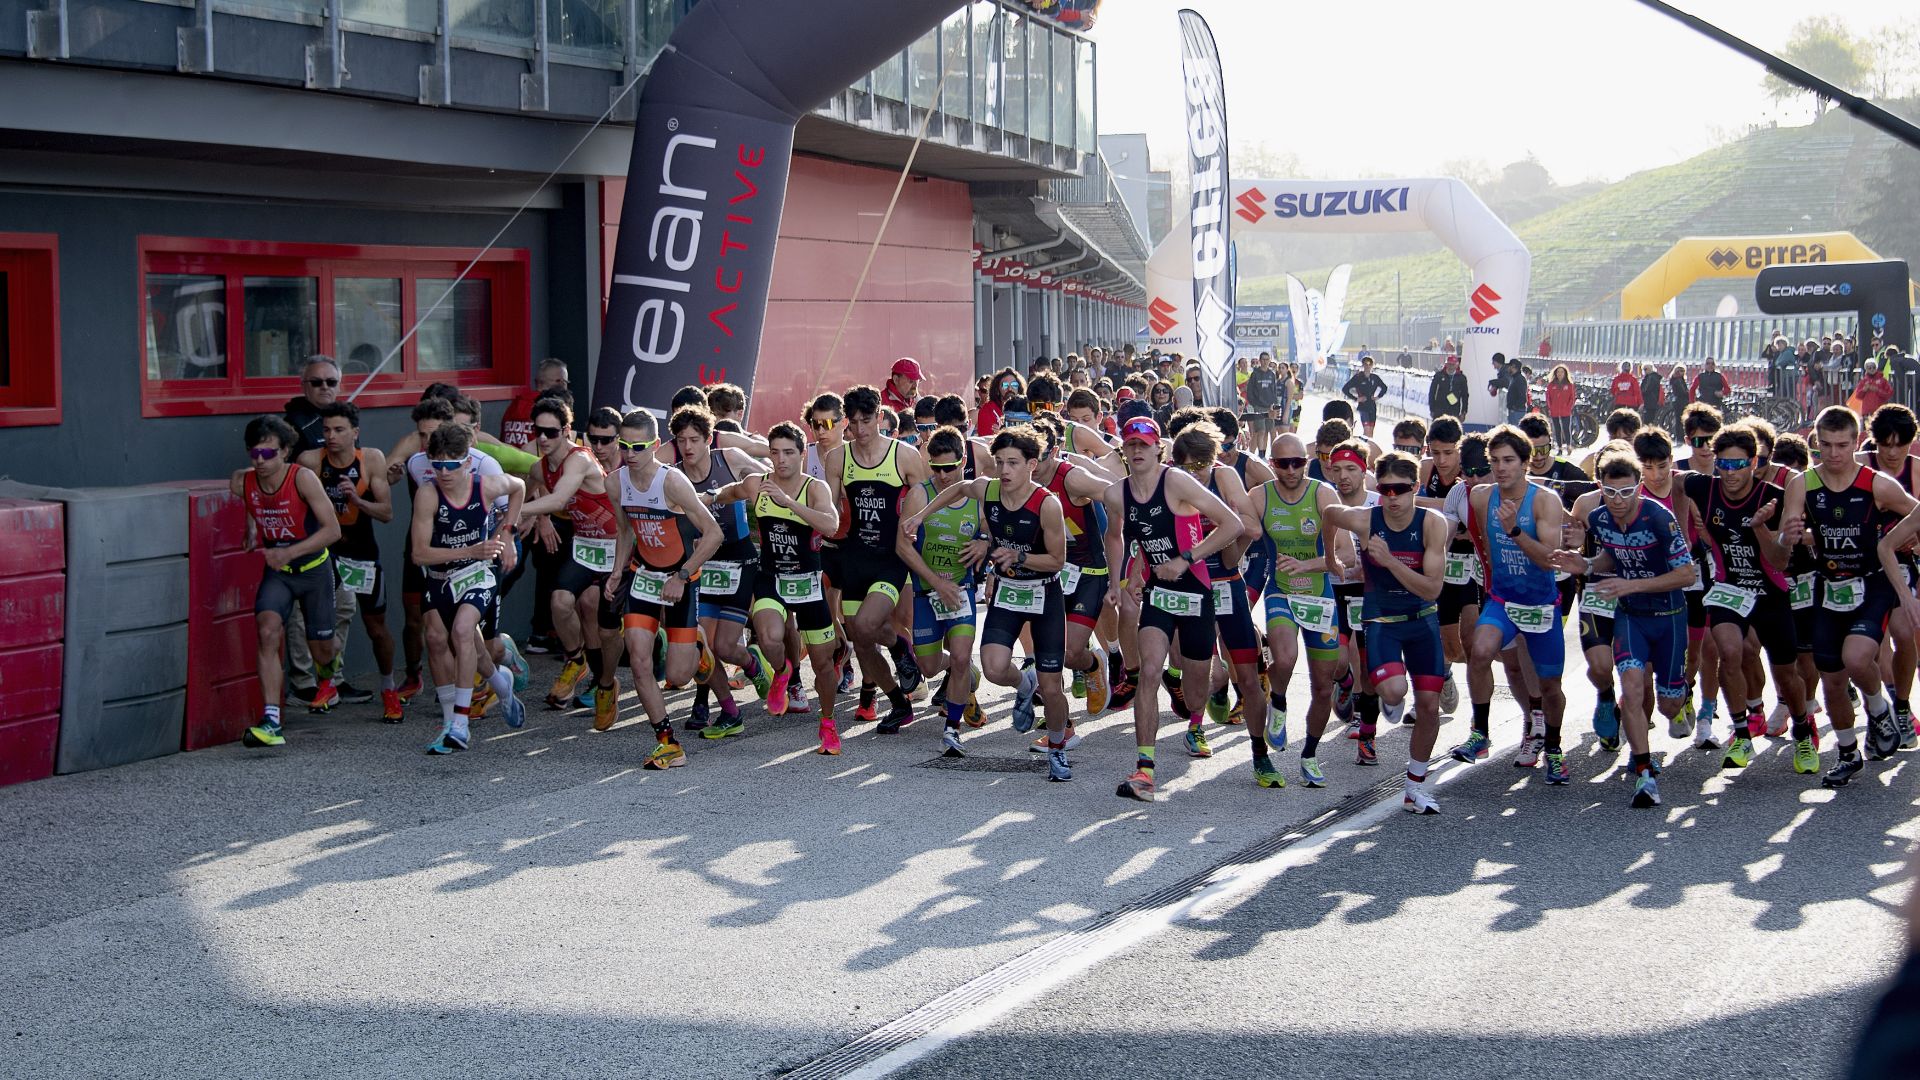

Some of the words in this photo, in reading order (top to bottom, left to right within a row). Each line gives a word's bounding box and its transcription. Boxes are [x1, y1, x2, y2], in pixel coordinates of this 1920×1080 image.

[1274, 187, 1409, 218] SUZUKI
[1770, 285, 1837, 297] COMPEX
[854, 496, 886, 509] CASADEI
[859, 508, 885, 522] ITA
[264, 527, 296, 539] ITA
[637, 521, 665, 536] LAMPE
[1819, 524, 1861, 537] Giovannini
[441, 528, 480, 545] Alessandri
[642, 536, 665, 548] ITA
[769, 531, 798, 546] BRUNI
[1823, 537, 1858, 549] ITA
[772, 543, 799, 556] ITA
[1141, 536, 1173, 552] CARBONI
[1722, 543, 1755, 558] PERRI
[577, 547, 596, 563] 41
[932, 555, 953, 568] ITA
[1731, 556, 1753, 569] ITA
[344, 567, 353, 583] 7
[1507, 565, 1528, 576] ITA
[635, 575, 657, 593] 56
[702, 572, 723, 587] 12
[786, 582, 799, 595] 8
[1006, 591, 1017, 603] 3
[1155, 592, 1179, 609] 18
[1296, 606, 1308, 620] 5
[1509, 608, 1532, 623] 22
